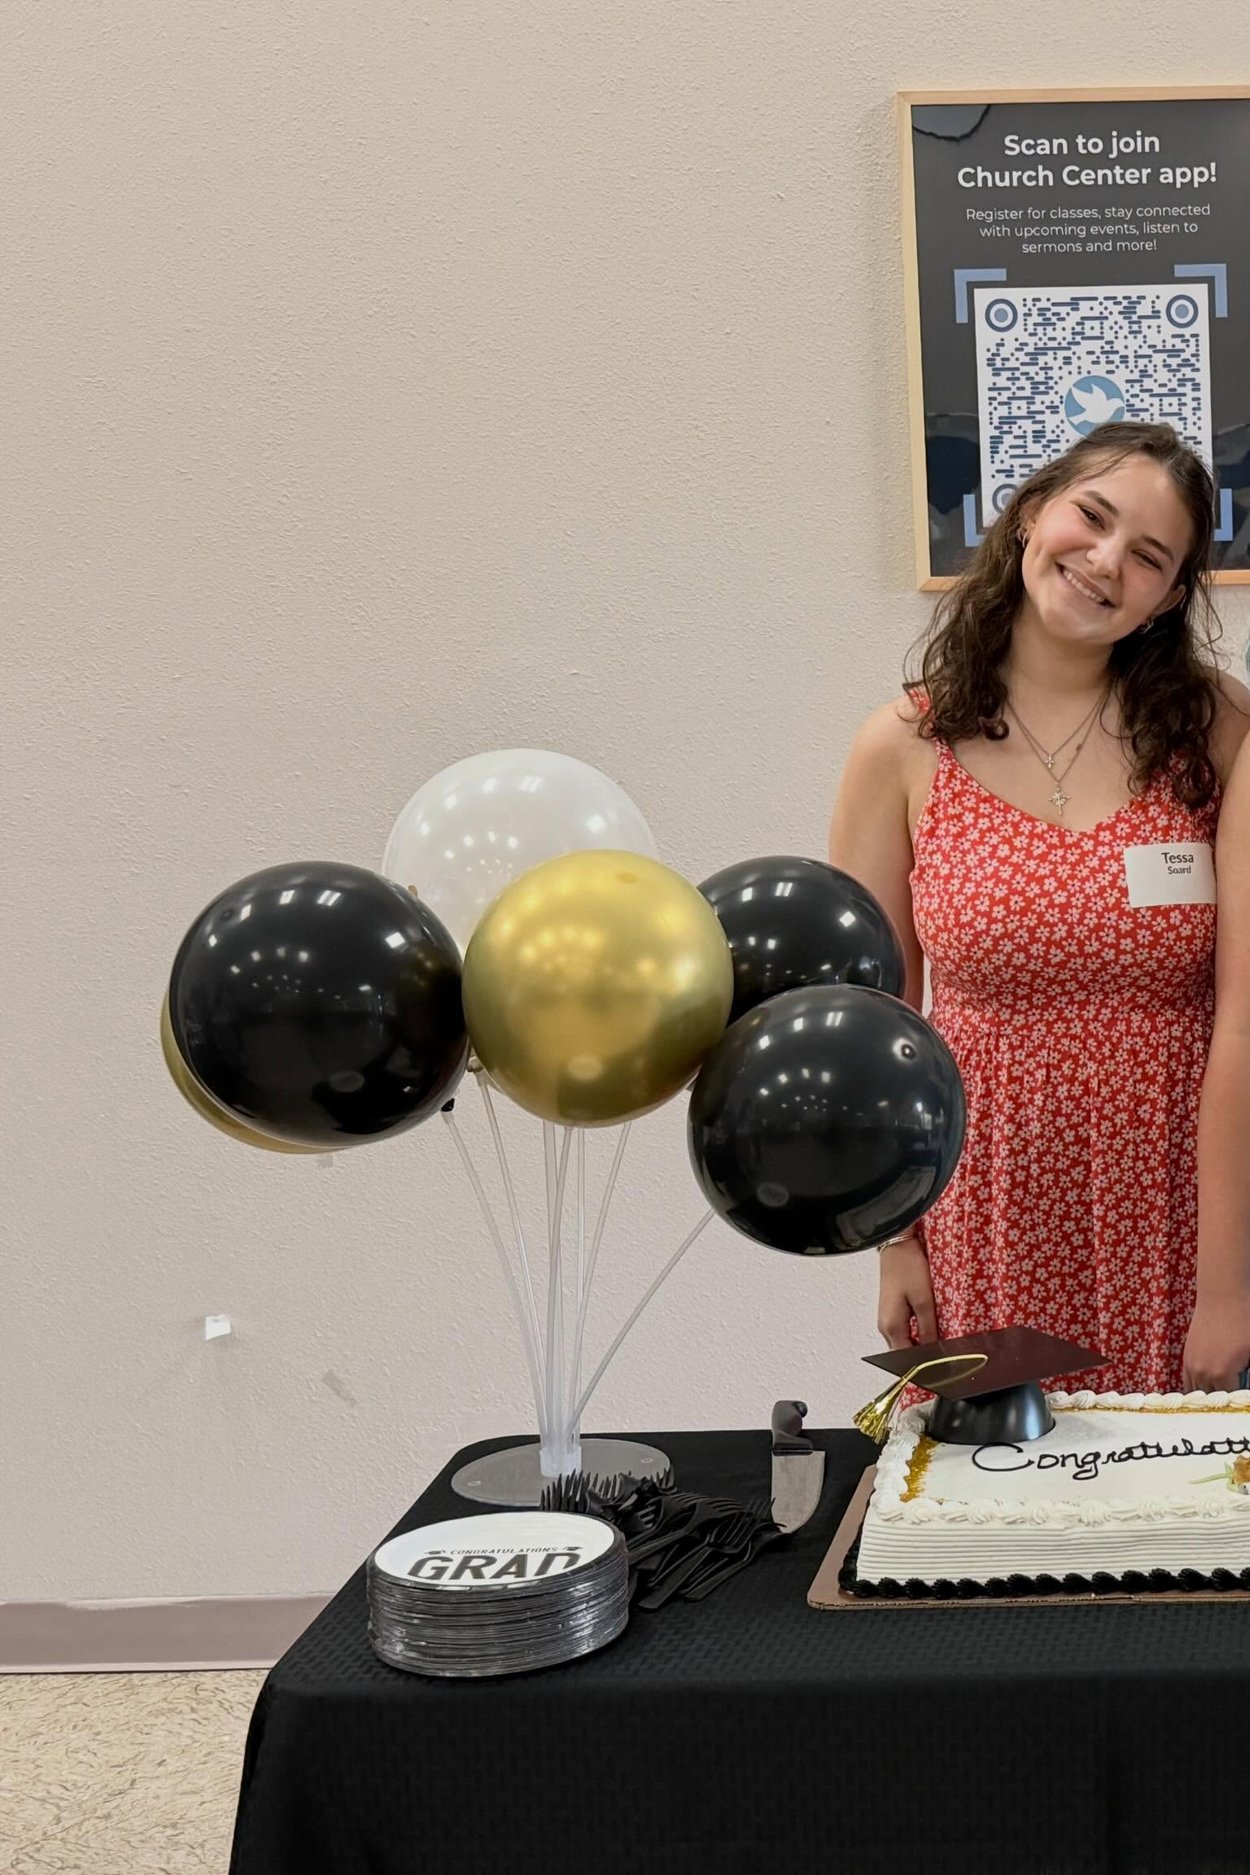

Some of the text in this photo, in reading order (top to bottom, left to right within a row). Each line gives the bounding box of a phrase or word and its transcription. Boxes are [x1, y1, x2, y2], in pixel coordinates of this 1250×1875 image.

[1004, 130, 1160, 159] Scan to join
[957, 162, 1217, 188] Church Center app!
[966, 203, 1211, 223] Register for classes, stay connected
[980, 221, 1199, 239] with upcoming events, listen to
[1022, 238, 1157, 254] sermons and more!
[1161, 852, 1194, 864] Tessa
[450, 1546, 558, 1555] CONGRATULATIONS
[407, 1552, 581, 1580] GRAD
